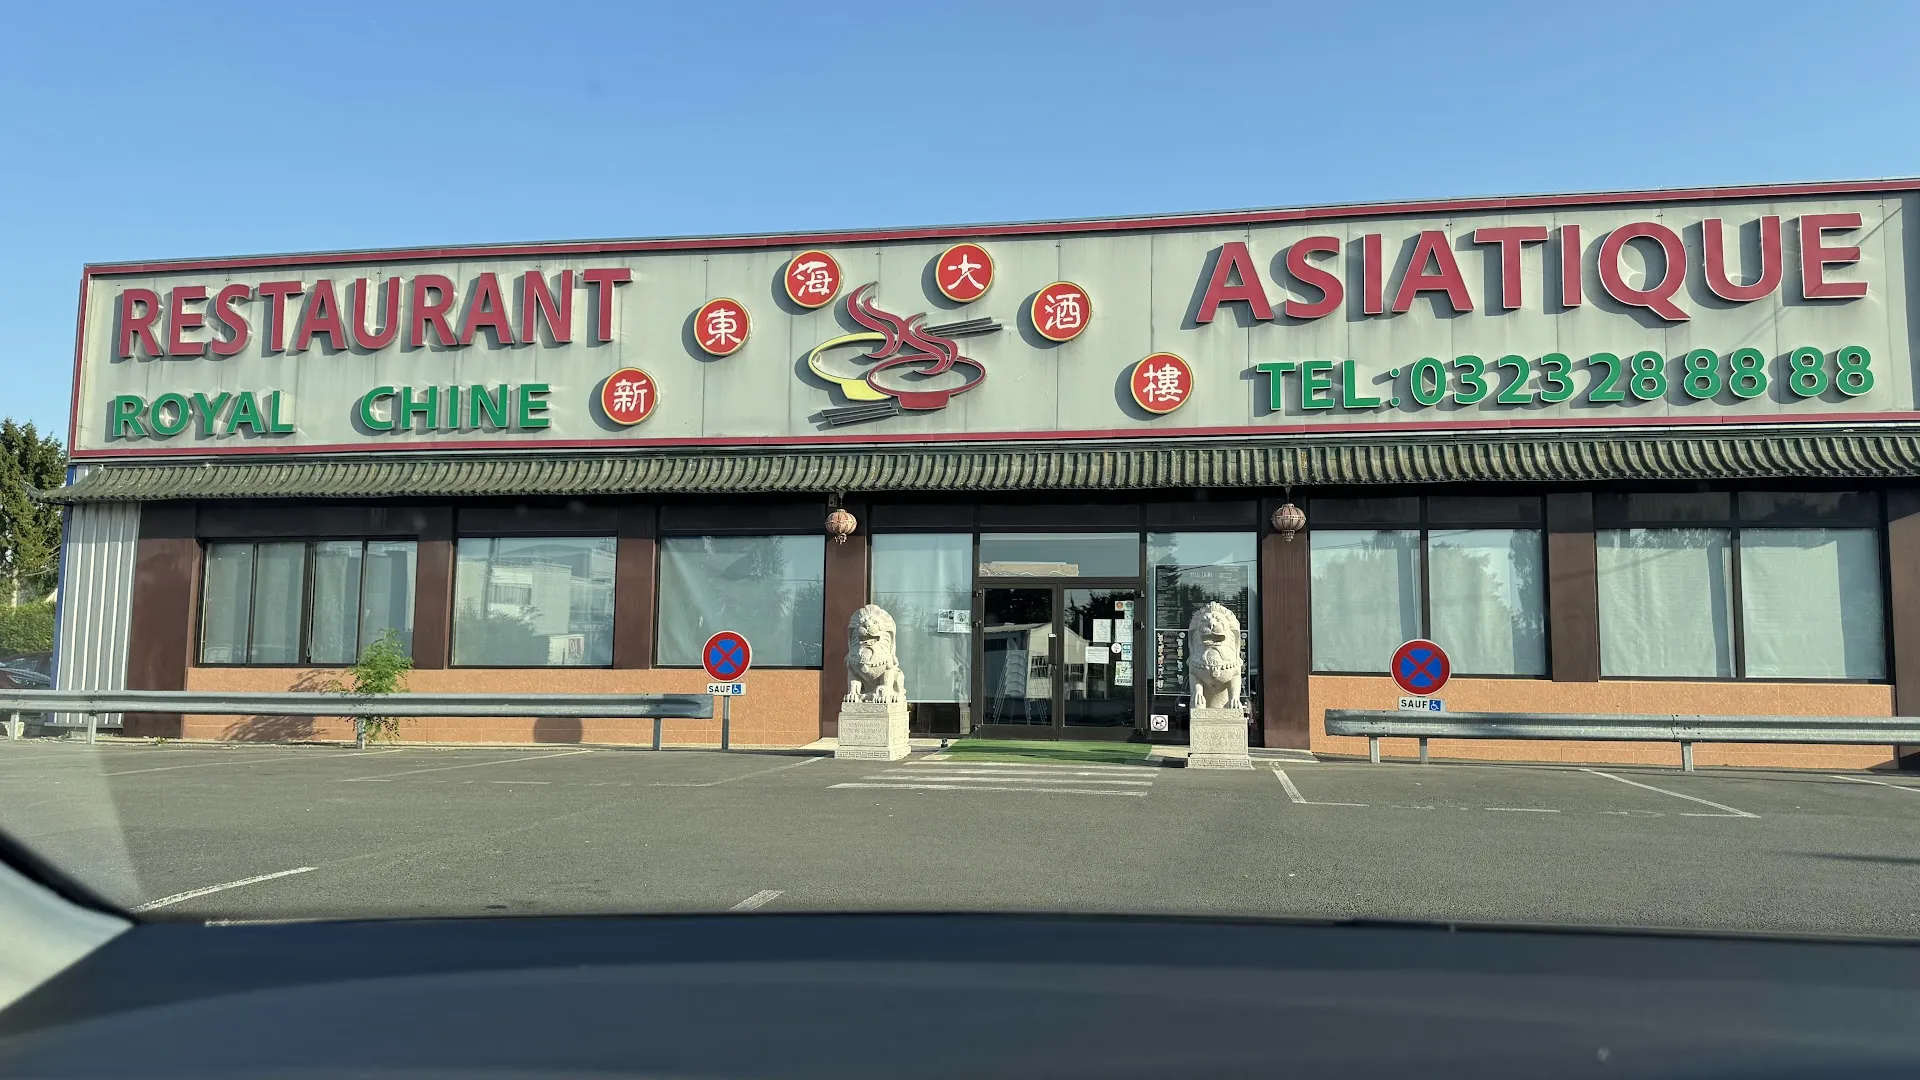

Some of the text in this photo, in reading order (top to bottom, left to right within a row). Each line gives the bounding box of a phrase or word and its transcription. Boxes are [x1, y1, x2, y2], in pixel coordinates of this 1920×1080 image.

[1195, 211, 1870, 322] ASIATIQUE
[118, 267, 633, 358] RESTAURANT
[613, 254, 1183, 414] 新 東 海 大 酒 樓
[112, 383, 550, 437] ROYAL CHINE
[708, 685, 731, 693] SAUF
[1401, 699, 1428, 709] SAUF
